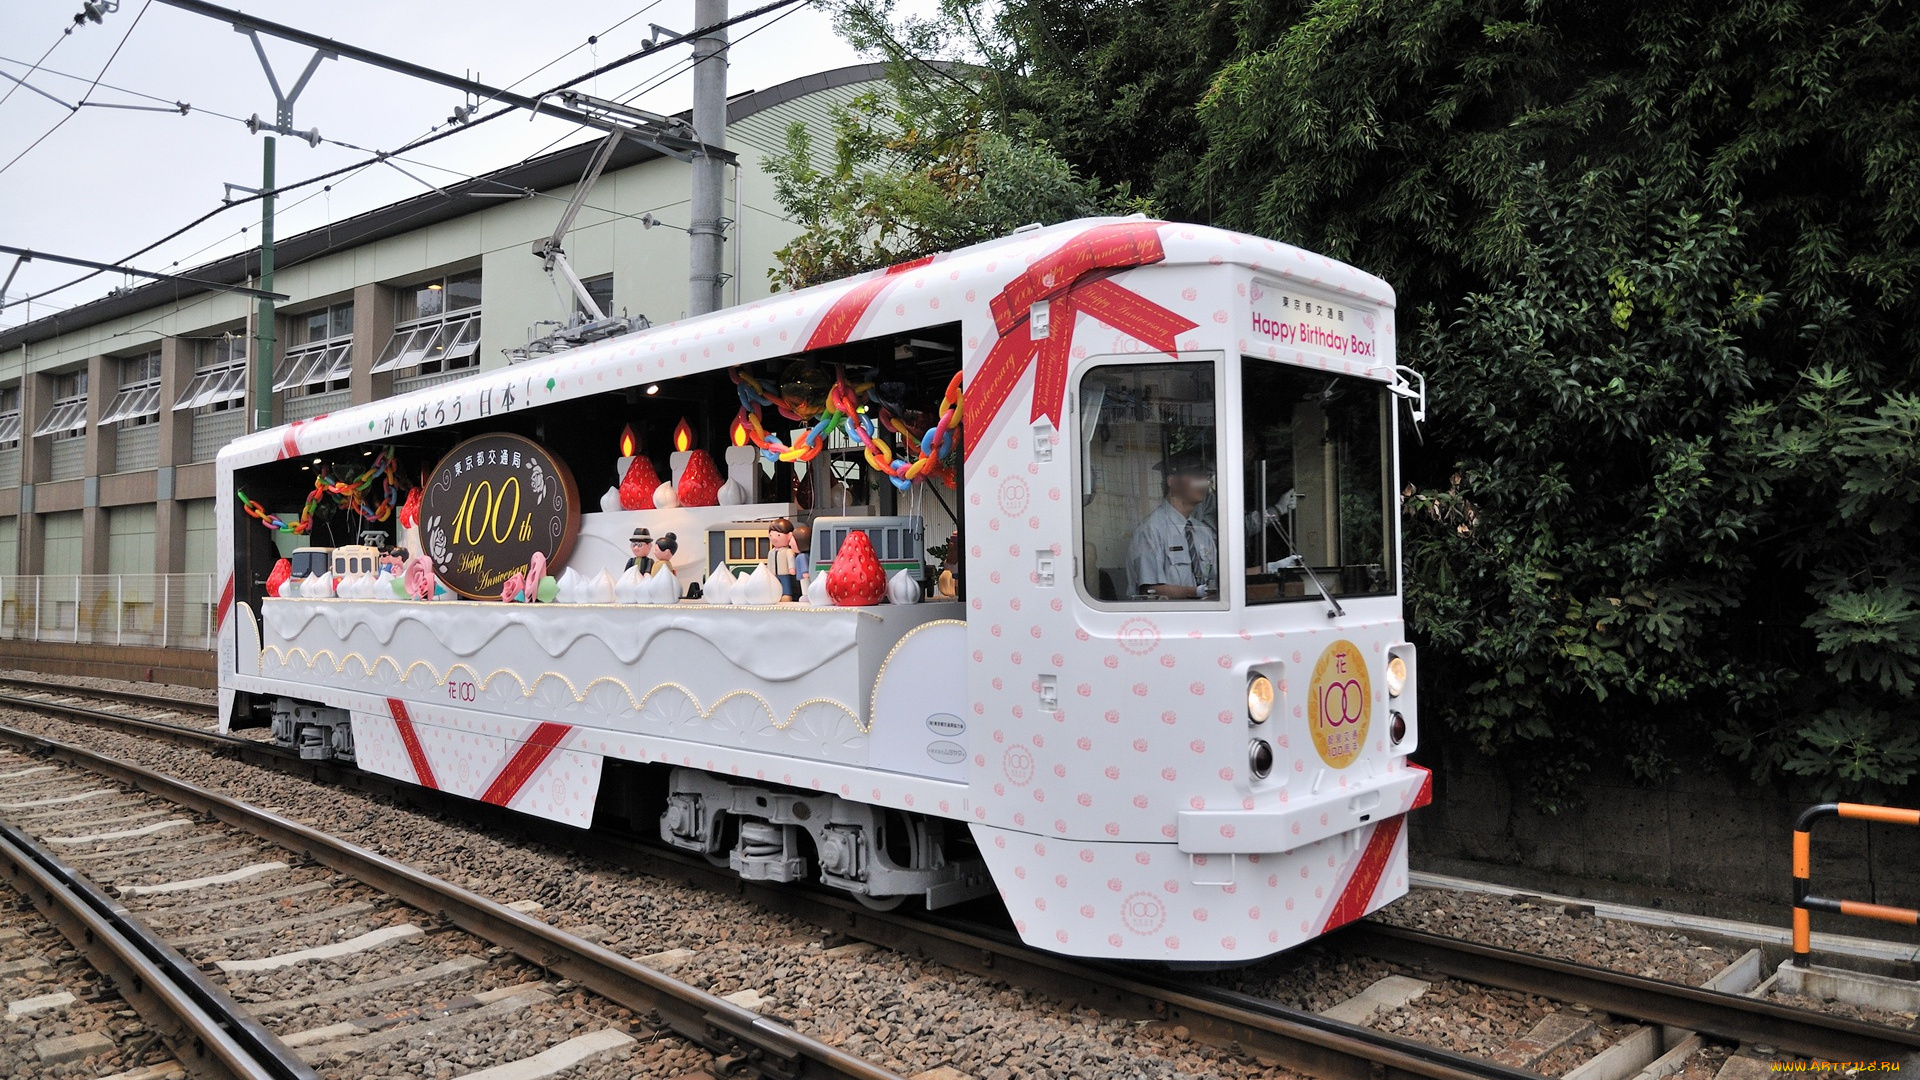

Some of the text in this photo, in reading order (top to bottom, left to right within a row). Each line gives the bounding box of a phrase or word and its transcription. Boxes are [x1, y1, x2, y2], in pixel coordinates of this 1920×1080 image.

[1032, 264, 1065, 290] Hppy
[1252, 311, 1375, 358] Happy Birthday Box!
[965, 353, 1016, 429] Anniversary
[454, 449, 521, 477] 東京都交通局
[457, 550, 485, 575] Happy
[1335, 653, 1347, 674] 花
[1319, 679, 1363, 728] 100
